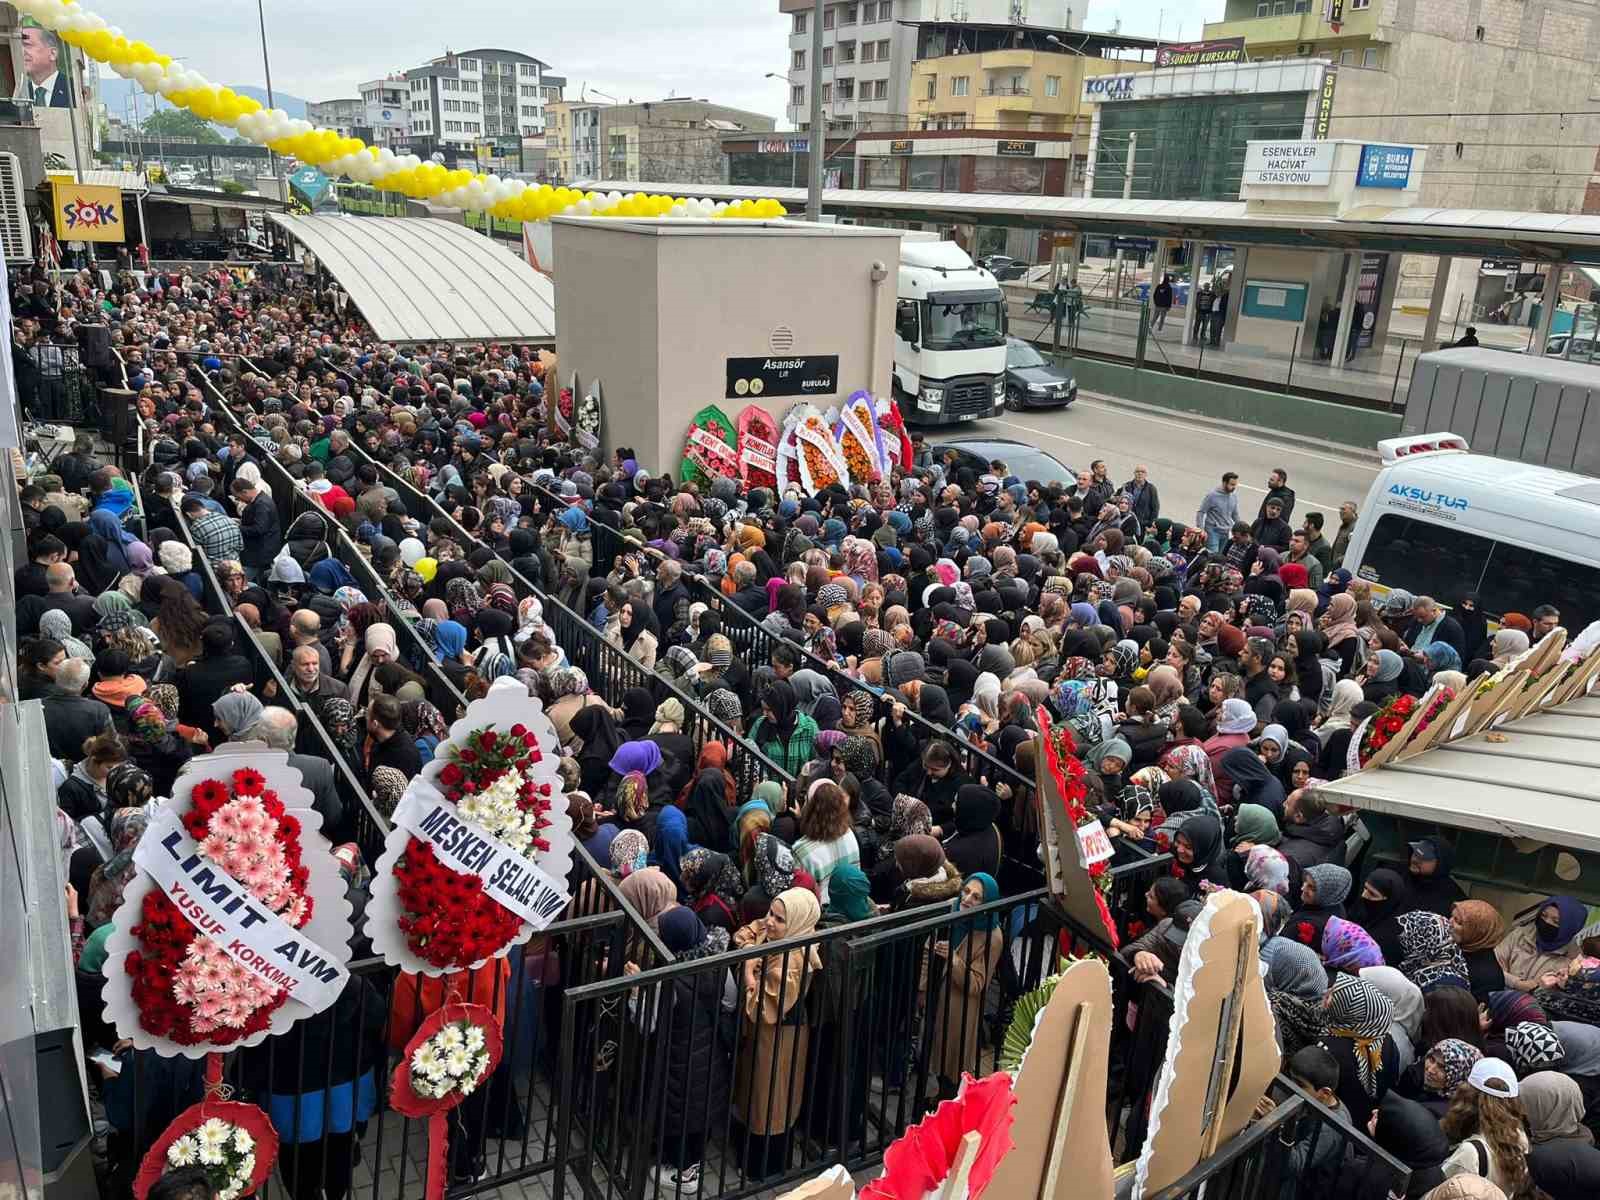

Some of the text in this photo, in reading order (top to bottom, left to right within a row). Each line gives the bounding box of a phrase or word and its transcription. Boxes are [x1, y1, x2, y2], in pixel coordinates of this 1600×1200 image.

[1200, 49, 1240, 62] KURSLARI
[1086, 77, 1135, 96] KOÇAK
[1262, 147, 1317, 157] ESENEVLER
[763, 358, 805, 370] Asansör
[1388, 484, 1433, 502] AKSU
[1436, 494, 1469, 511] TUR
[419, 806, 566, 919] MESKEN ŞELALE AVM
[161, 830, 341, 985] LİMİT AVM
[168, 880, 300, 992] YUSUF KORKMAZ
